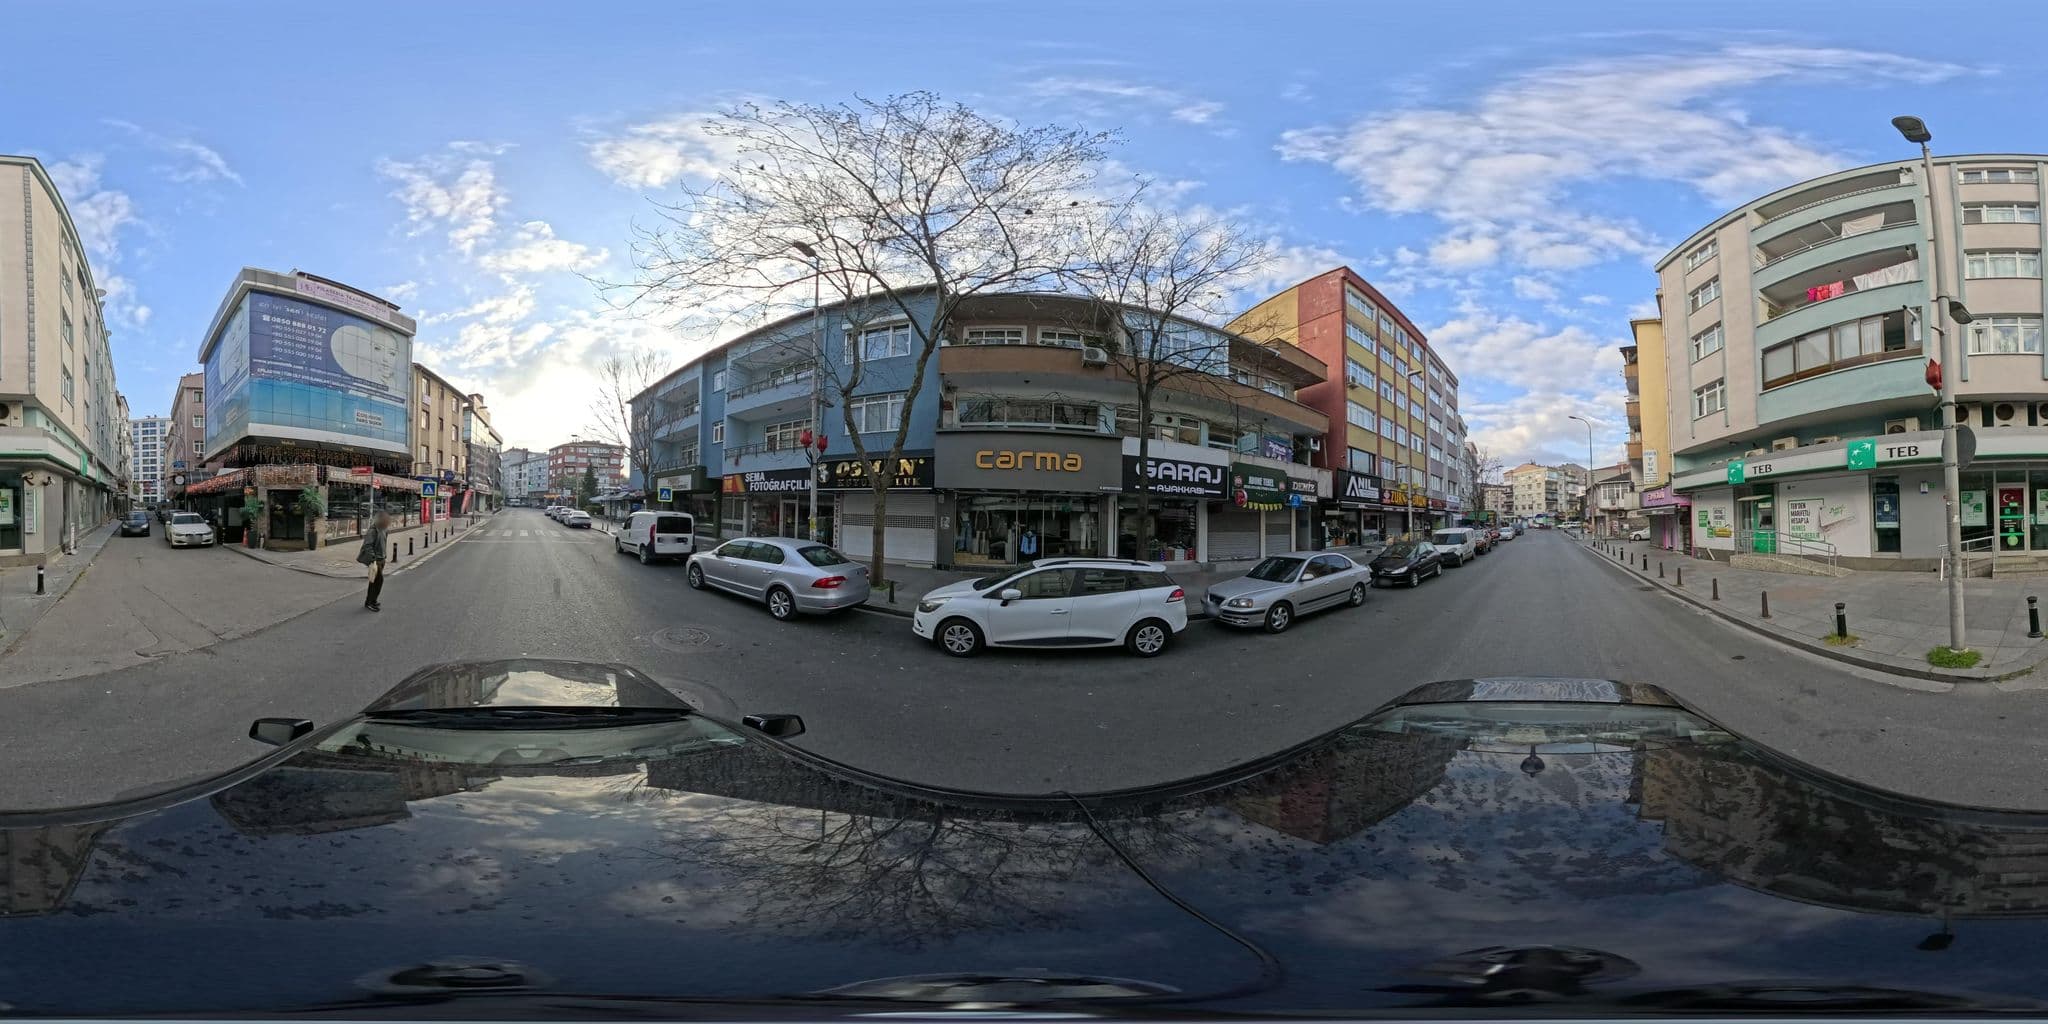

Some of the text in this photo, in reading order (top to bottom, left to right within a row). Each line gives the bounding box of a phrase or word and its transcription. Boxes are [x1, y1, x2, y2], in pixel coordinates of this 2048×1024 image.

[1885, 445, 1920, 459] TEB
[975, 449, 1083, 472] carma
[1135, 460, 1222, 484] GARAJ
[1751, 463, 1773, 475] TEB
[745, 472, 766, 482] SEMA
[1156, 484, 1205, 495] AYAKKABI
